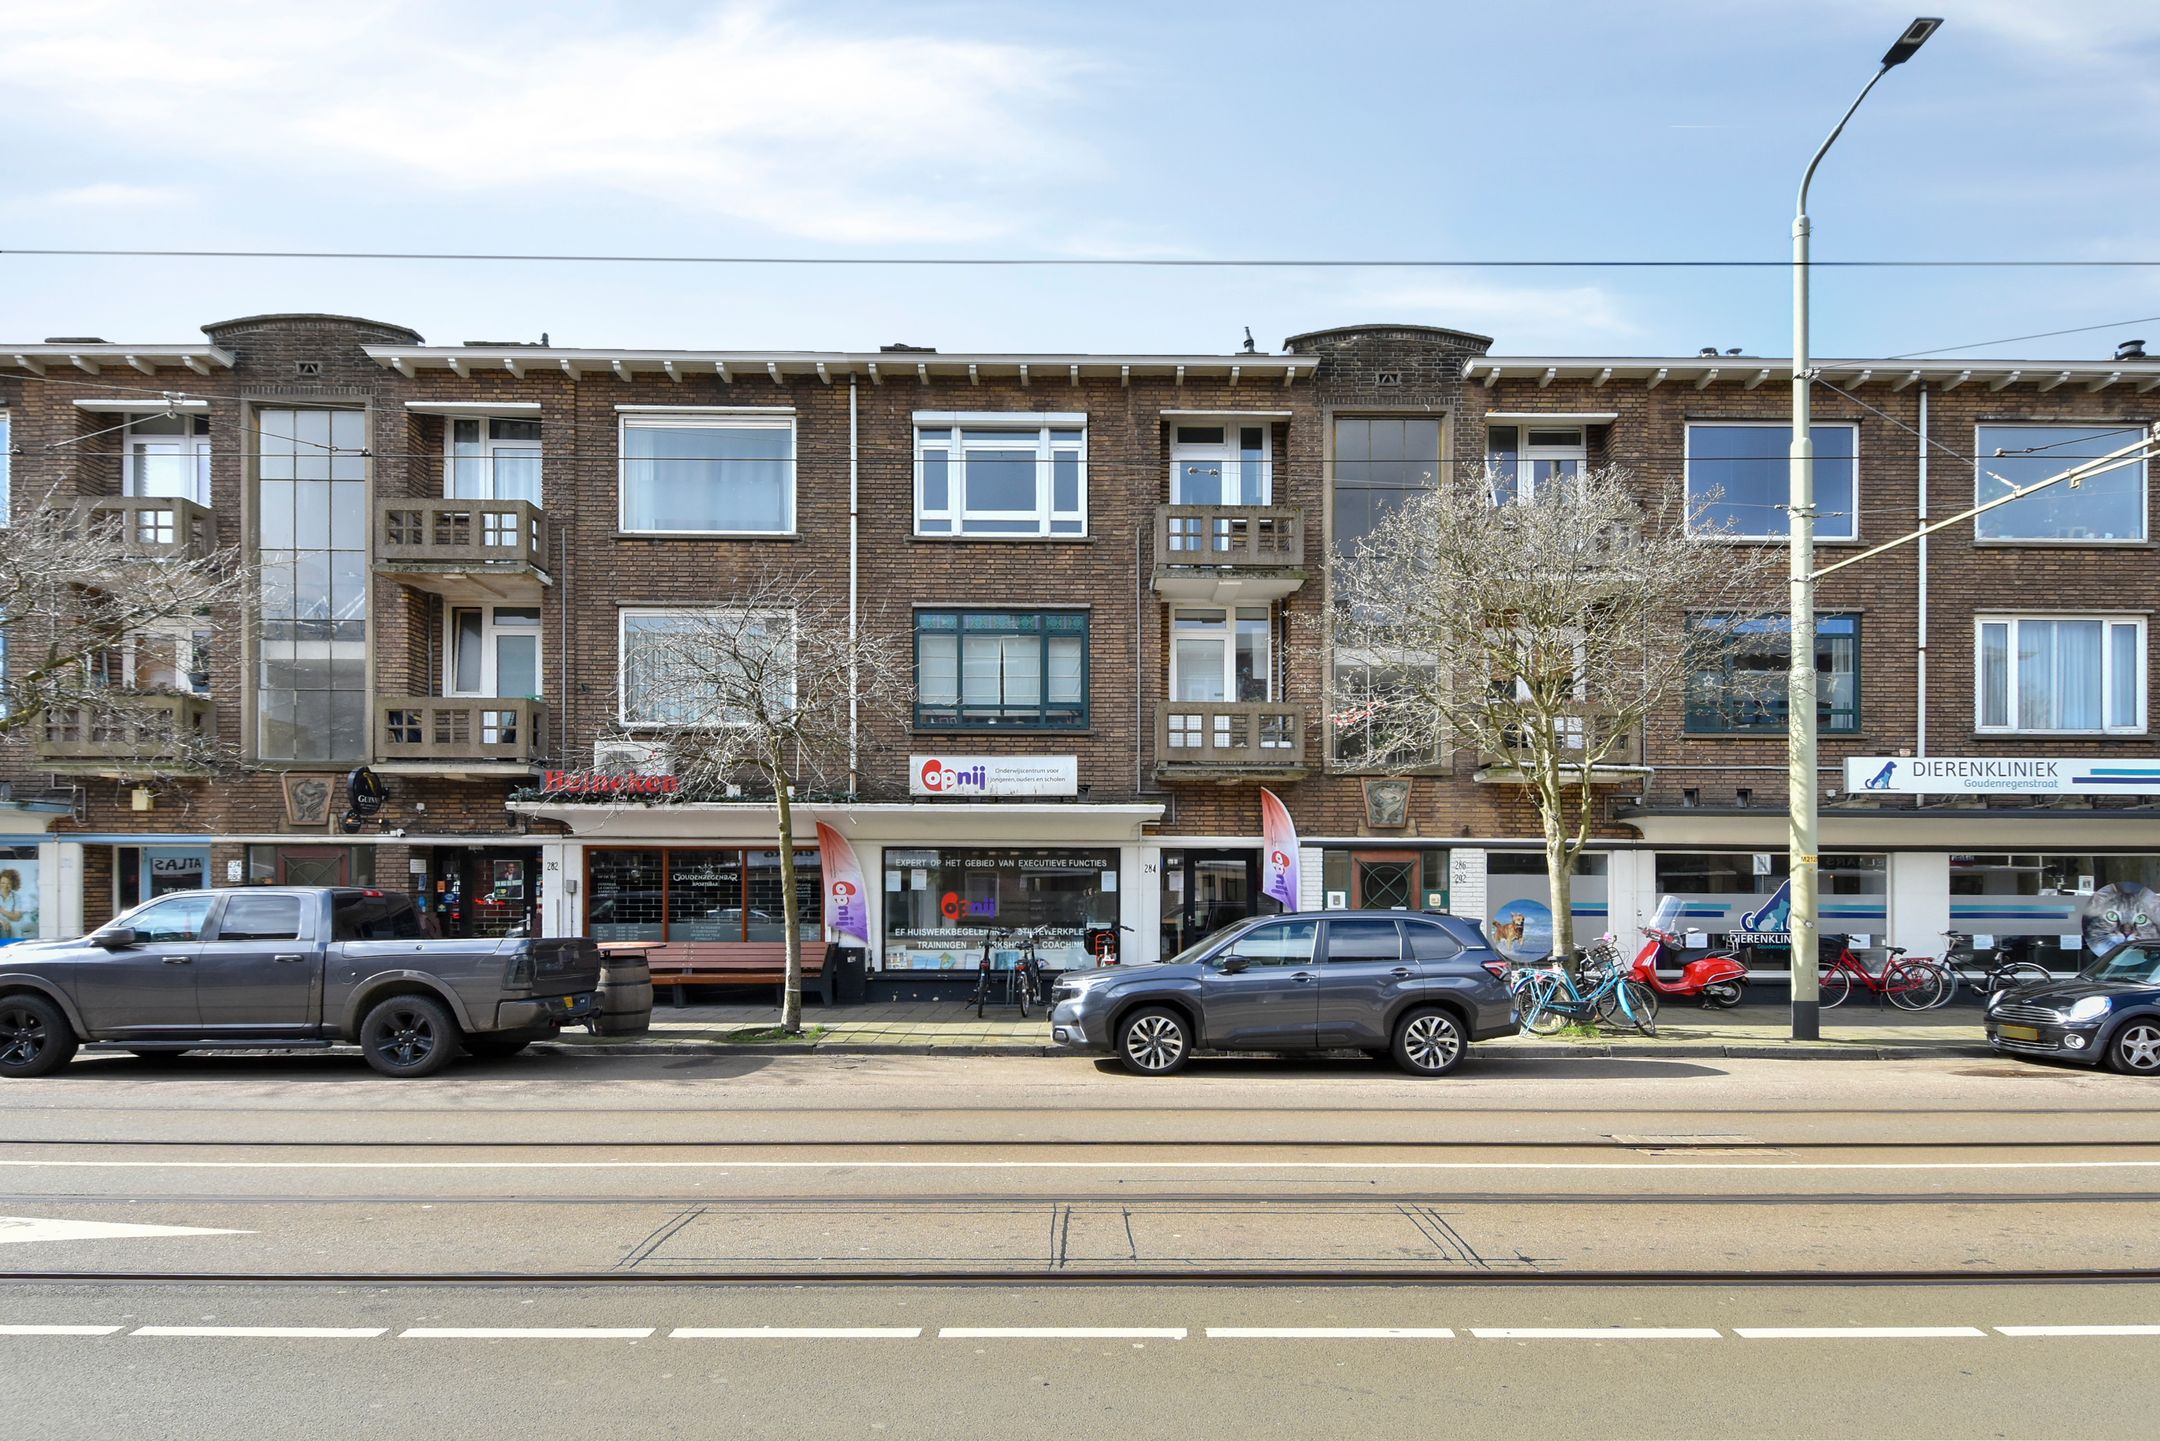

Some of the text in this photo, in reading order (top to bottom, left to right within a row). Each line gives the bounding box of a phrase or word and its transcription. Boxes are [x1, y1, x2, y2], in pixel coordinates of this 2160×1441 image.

[1913, 761, 2058, 777] DIERENKLINIEK
[545, 768, 681, 793] Heineken
[1964, 779, 2058, 790] Goudenregenstraat
[546, 862, 559, 871] 282
[895, 859, 1107, 867] EXPERT OP HET GEBIED VAN EXECUTIEVE FUNCTIES
[1144, 863, 1157, 873] 284
[895, 928, 905, 936] EF
[1730, 934, 1791, 944] DIERENKLIN
[917, 941, 967, 949] TRAININGEN
